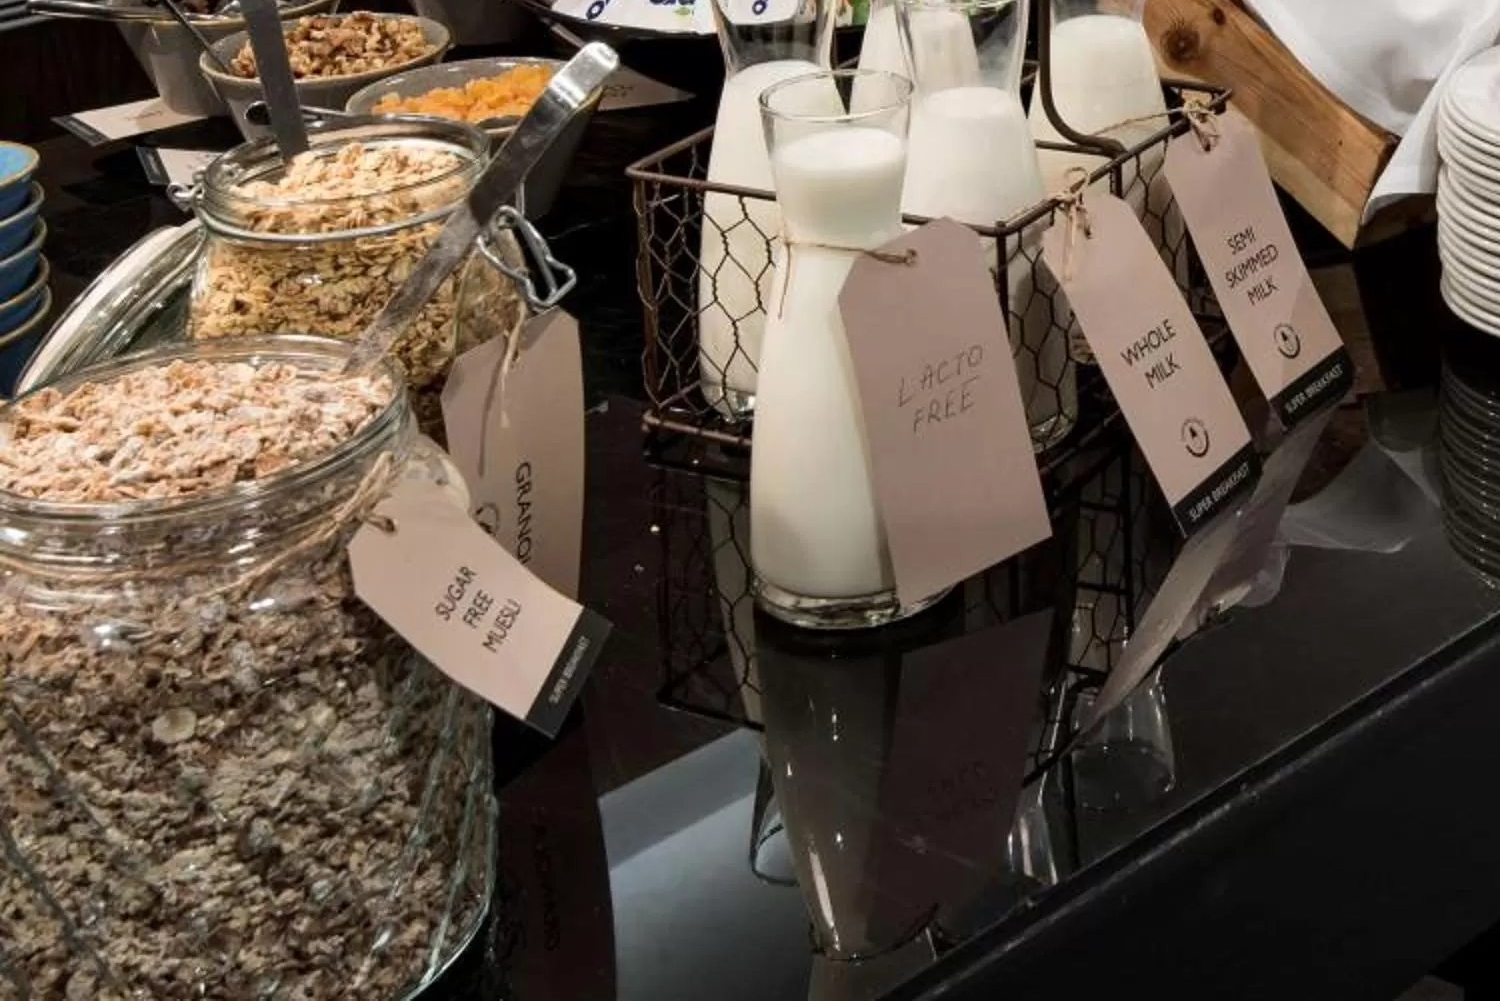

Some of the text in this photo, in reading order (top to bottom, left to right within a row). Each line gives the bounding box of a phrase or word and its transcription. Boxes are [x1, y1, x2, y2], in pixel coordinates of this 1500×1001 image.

[1227, 227, 1255, 254] SEMI
[1225, 244, 1279, 289] SKIMMED
[1247, 275, 1279, 306] MILK
[1120, 318, 1177, 367] WHOLE
[898, 344, 984, 408] LACTO
[1144, 352, 1181, 389] MILK
[913, 374, 983, 433] FREE
[1187, 462, 1250, 523] SUPER BREAKFAST
[435, 566, 477, 621] SUGAR
[462, 589, 494, 628] FREE
[482, 599, 521, 653] MUESLI
